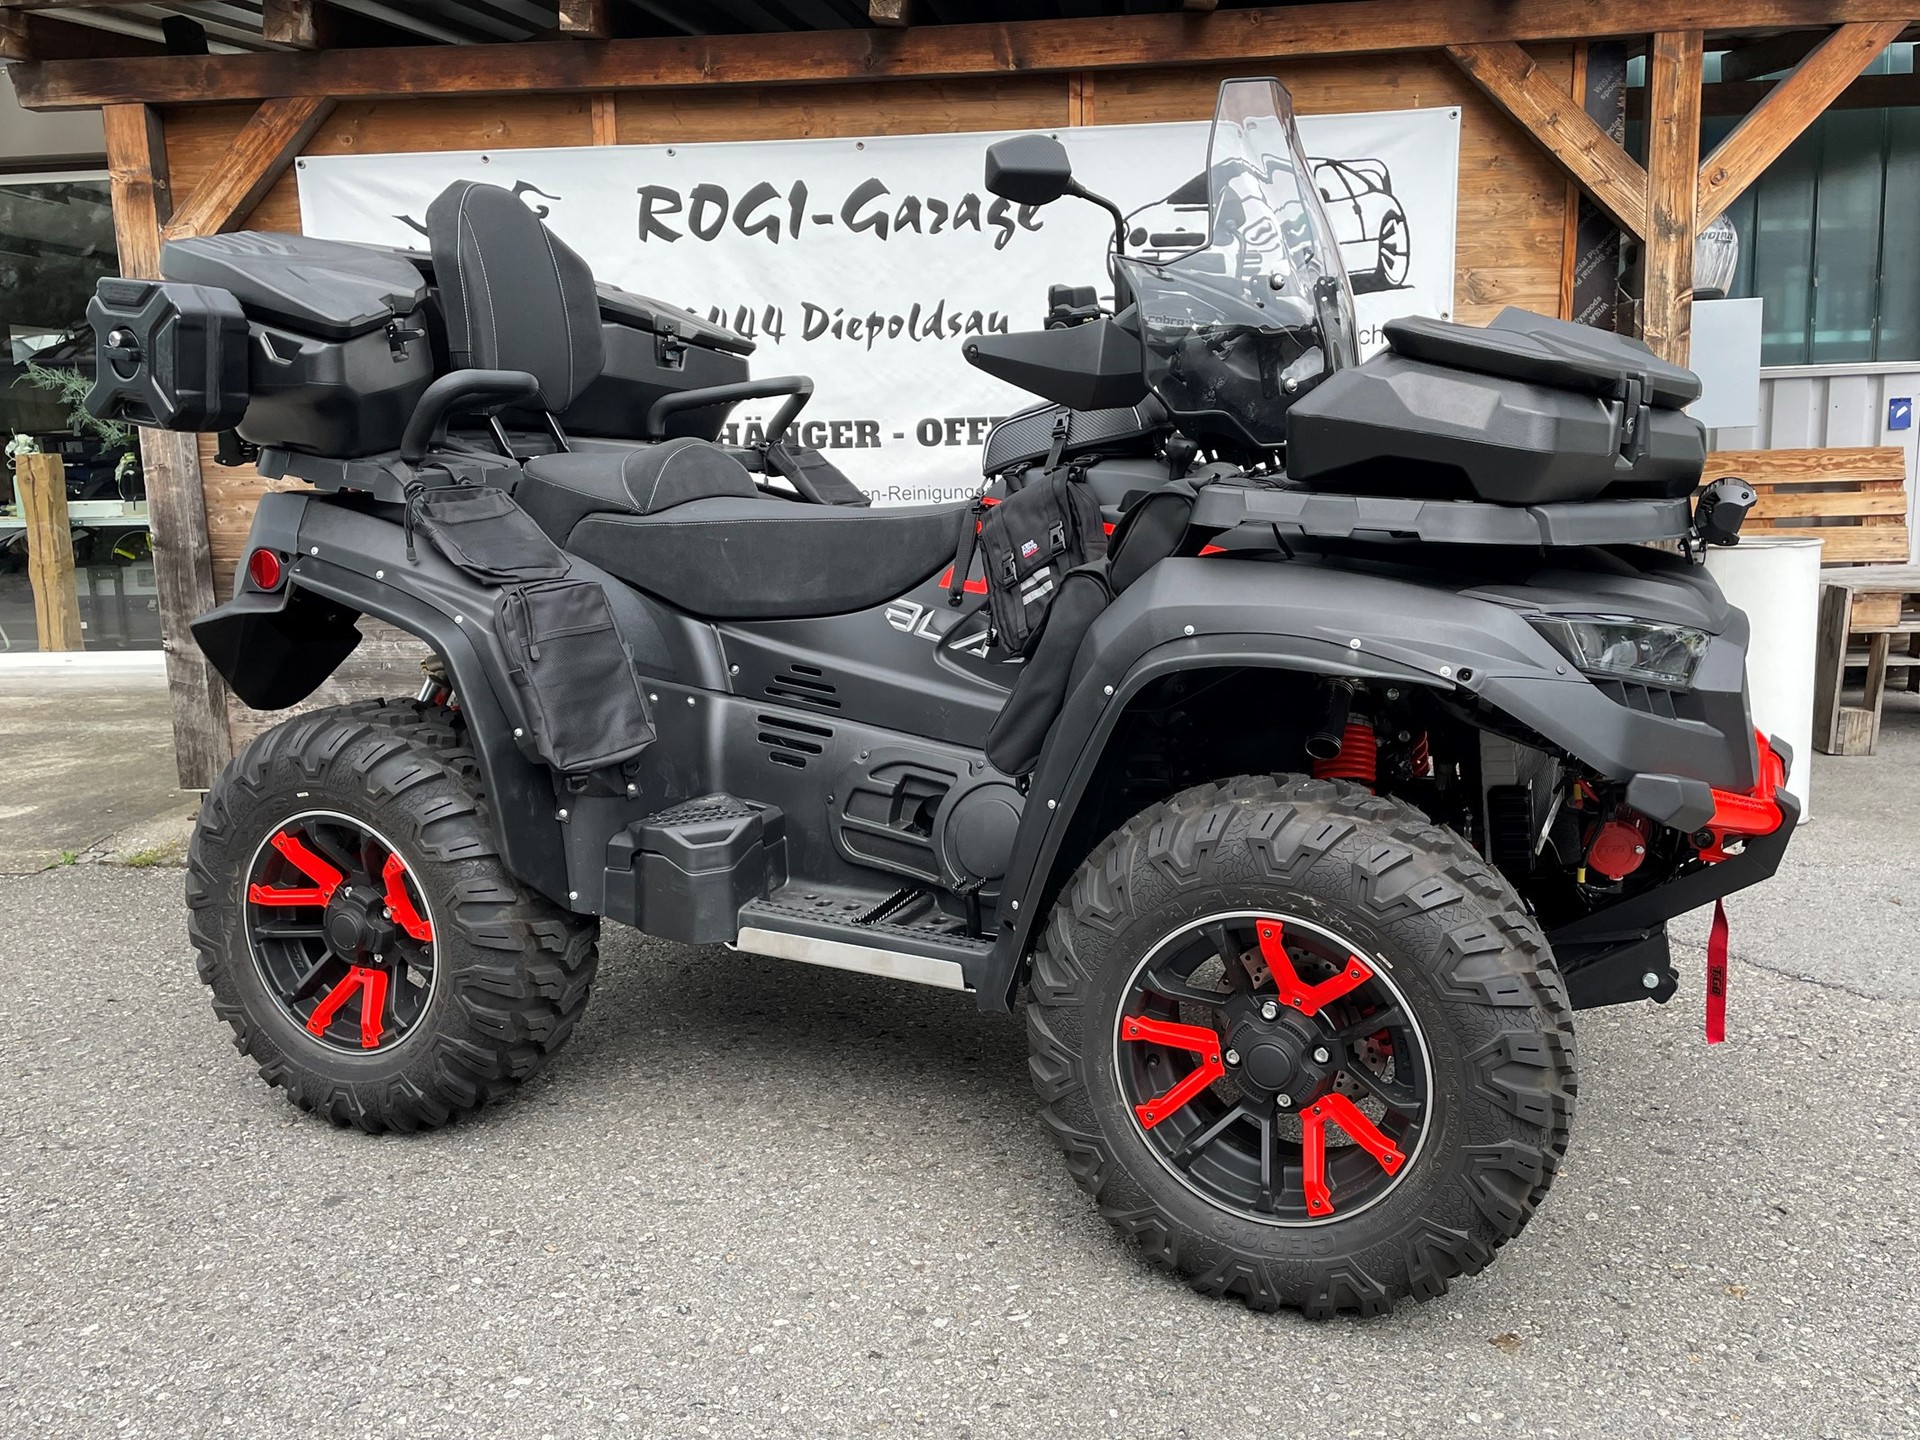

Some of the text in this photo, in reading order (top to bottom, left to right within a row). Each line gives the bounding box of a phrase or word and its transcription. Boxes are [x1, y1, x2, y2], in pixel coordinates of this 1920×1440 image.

[637, 177, 1043, 251] ROGI-Garage
[686, 298, 1008, 351] 444 Diepoldsau
